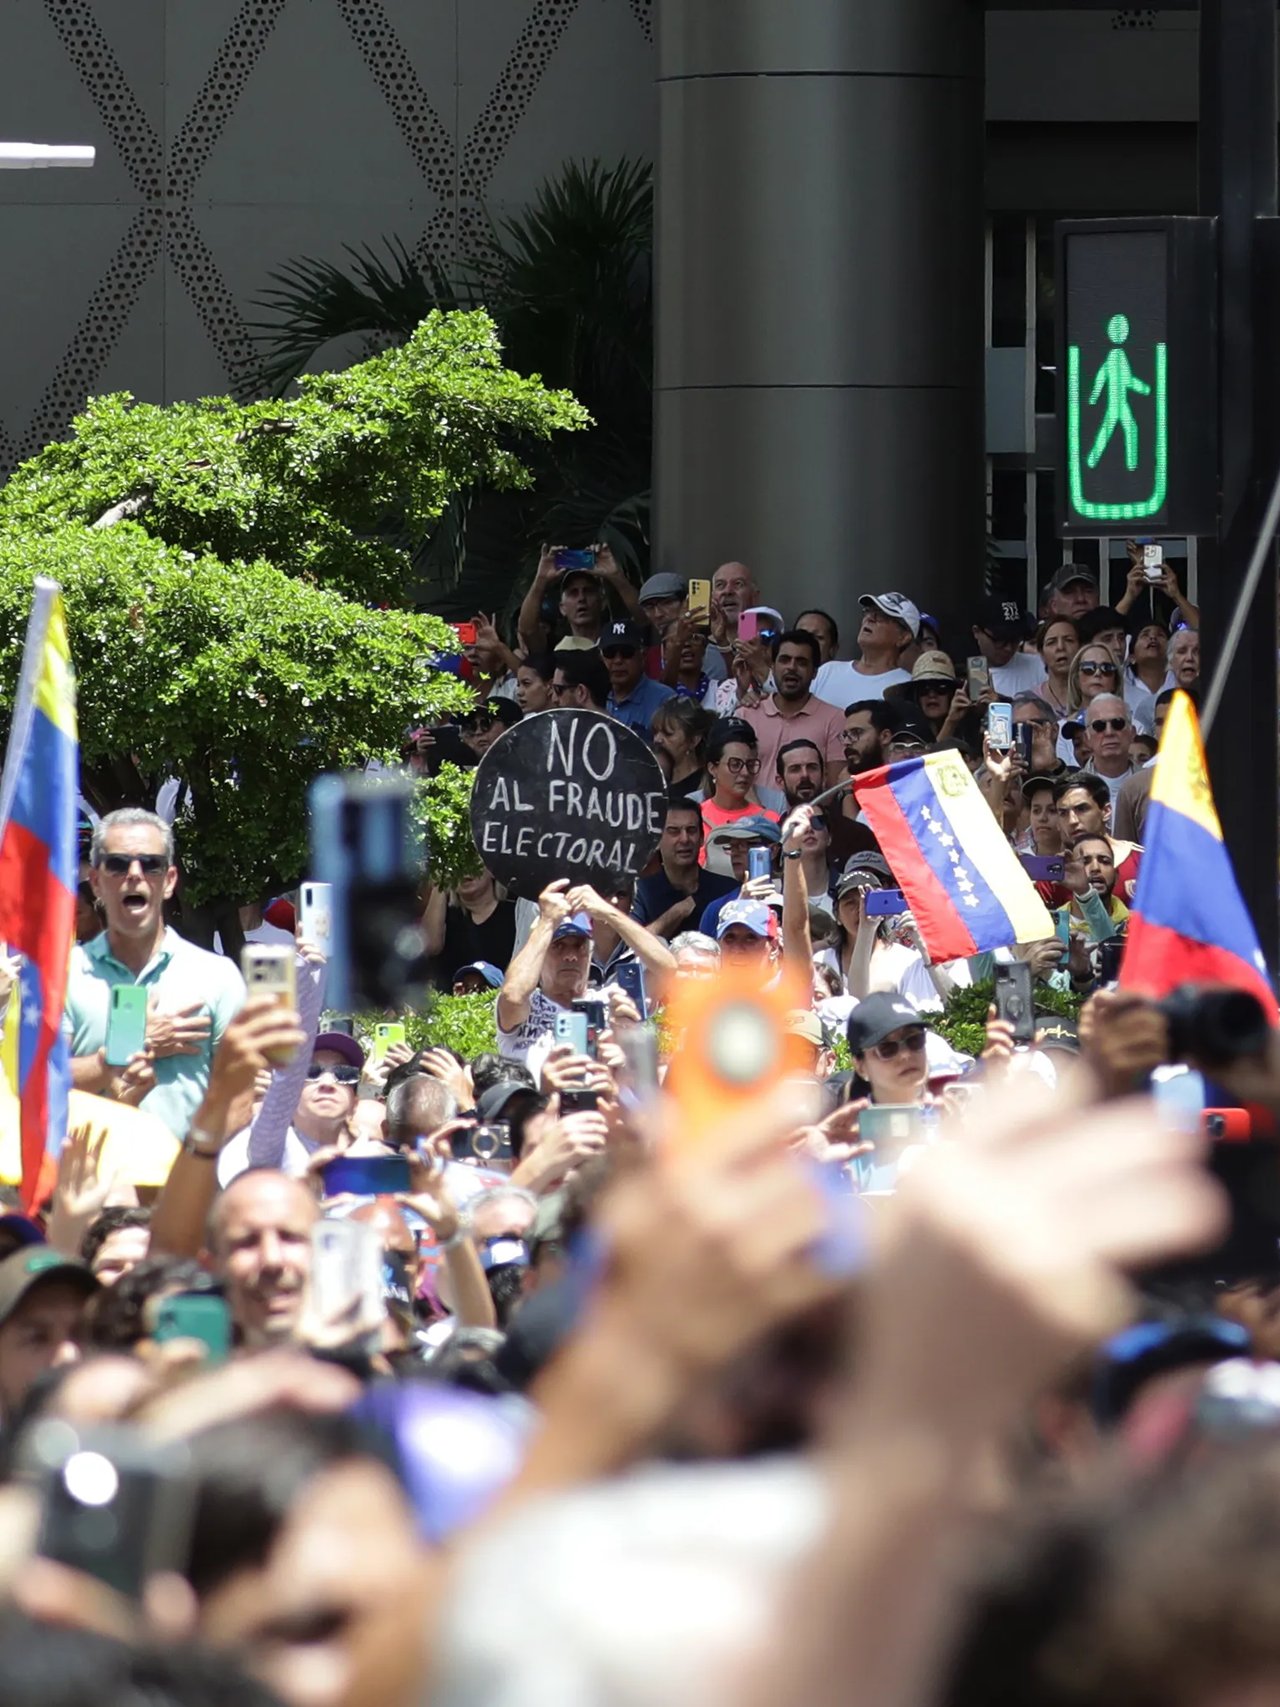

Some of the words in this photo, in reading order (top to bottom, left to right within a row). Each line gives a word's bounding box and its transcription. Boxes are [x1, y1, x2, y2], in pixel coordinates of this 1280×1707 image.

[546, 717, 617, 781] NO
[488, 776, 535, 812] AL
[548, 779, 665, 834] FRAUDE
[482, 821, 638, 874] ELECTORAL
